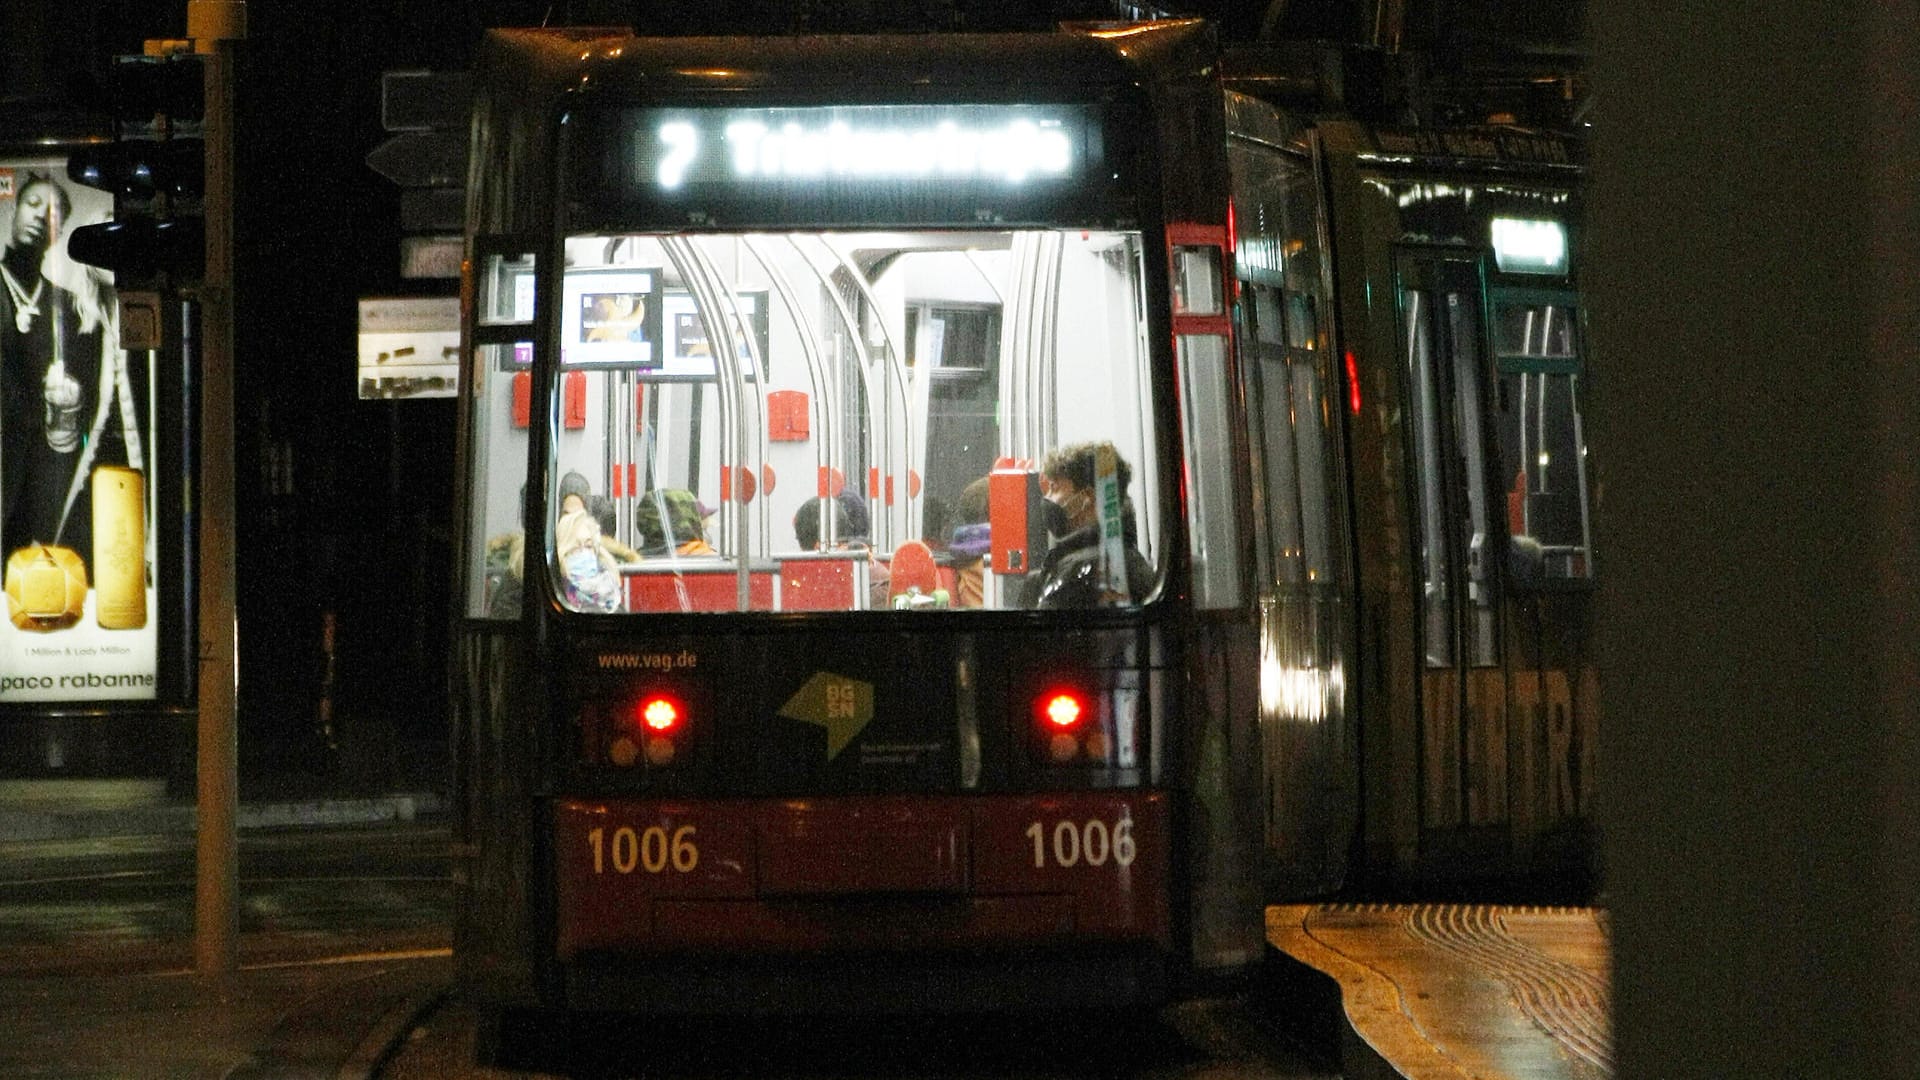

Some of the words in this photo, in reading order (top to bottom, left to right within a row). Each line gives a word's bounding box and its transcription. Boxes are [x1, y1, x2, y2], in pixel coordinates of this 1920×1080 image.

[658, 122, 698, 188] 7
[31, 647, 62, 657] Million
[64, 647, 71, 656] &
[75, 647, 97, 657] Lady
[101, 646, 131, 656] Million
[598, 649, 697, 673] www.vag.de
[0, 675, 54, 693] paco
[60, 672, 153, 689] rabanne
[588, 825, 699, 874] 1006
[1025, 818, 1137, 868] 1006
